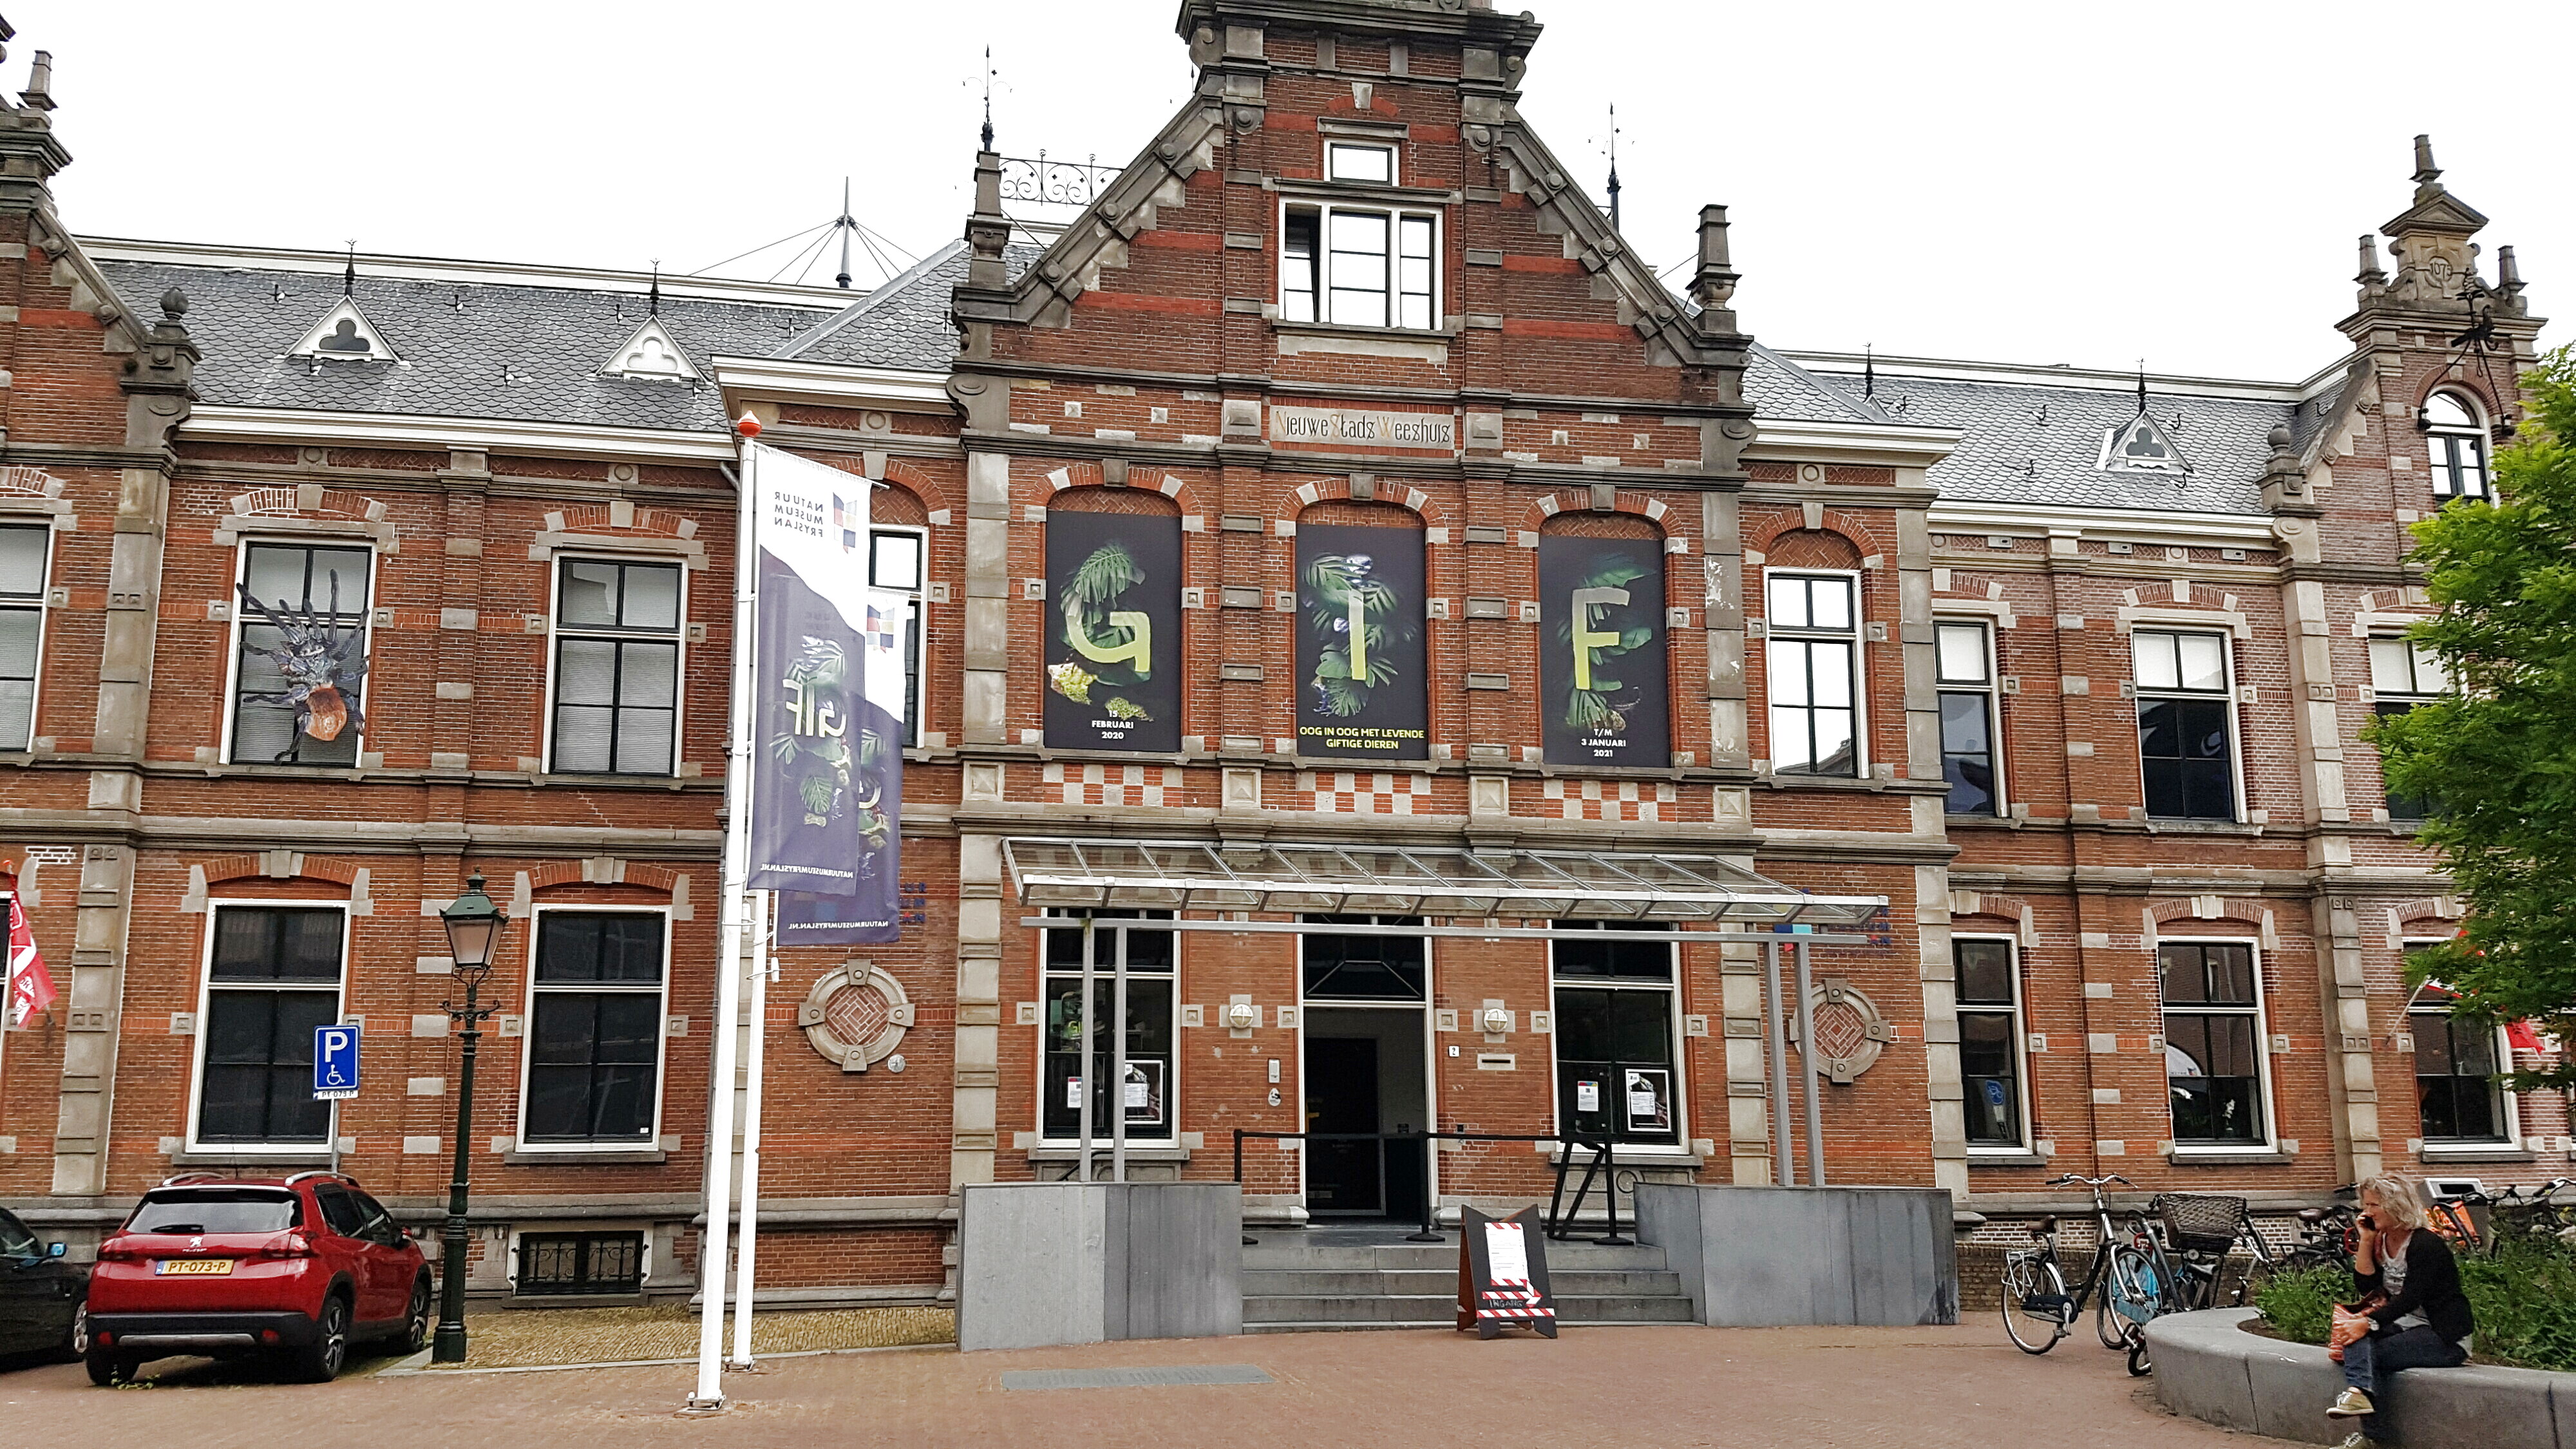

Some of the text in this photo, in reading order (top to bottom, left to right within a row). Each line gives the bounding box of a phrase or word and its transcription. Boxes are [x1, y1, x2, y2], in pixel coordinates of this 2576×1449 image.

[1330, 413, 1376, 439] Stads
[1065, 591, 1151, 672] G
[1572, 587, 1630, 690] F
[1091, 720, 1134, 729] FEBRUARI
[1101, 731, 1124, 739] 2020
[1300, 726, 1425, 738] OOG IN OOG MET LEVENDE
[1326, 739, 1399, 750] GIFTIGE DIEREN
[325, 1032, 348, 1063] P
[1452, 1046, 1457, 1056] 2
[168, 1262, 226, 1271] PT-073-P
[1489, 1300, 1523, 1308] INGANG
